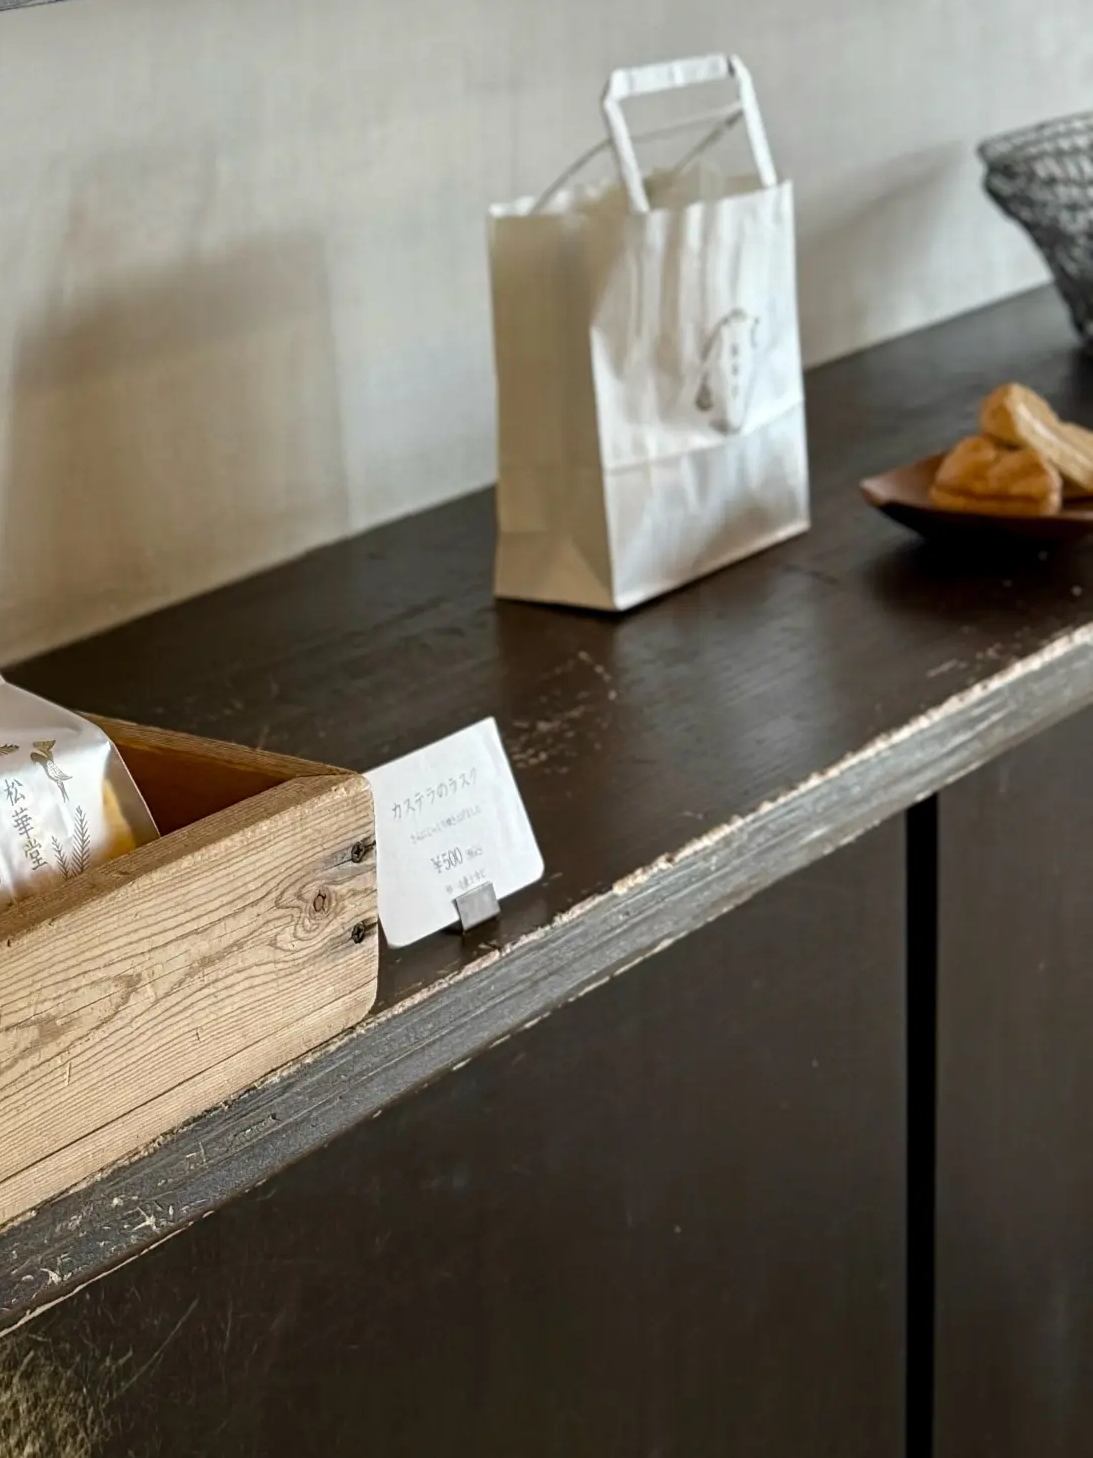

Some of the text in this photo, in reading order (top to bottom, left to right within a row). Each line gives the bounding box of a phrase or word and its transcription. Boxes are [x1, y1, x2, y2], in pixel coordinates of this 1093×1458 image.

[391, 768, 477, 820] カステラのラスク
[4, 778, 48, 871] 松華堂
[431, 847, 463, 873] ¥500
